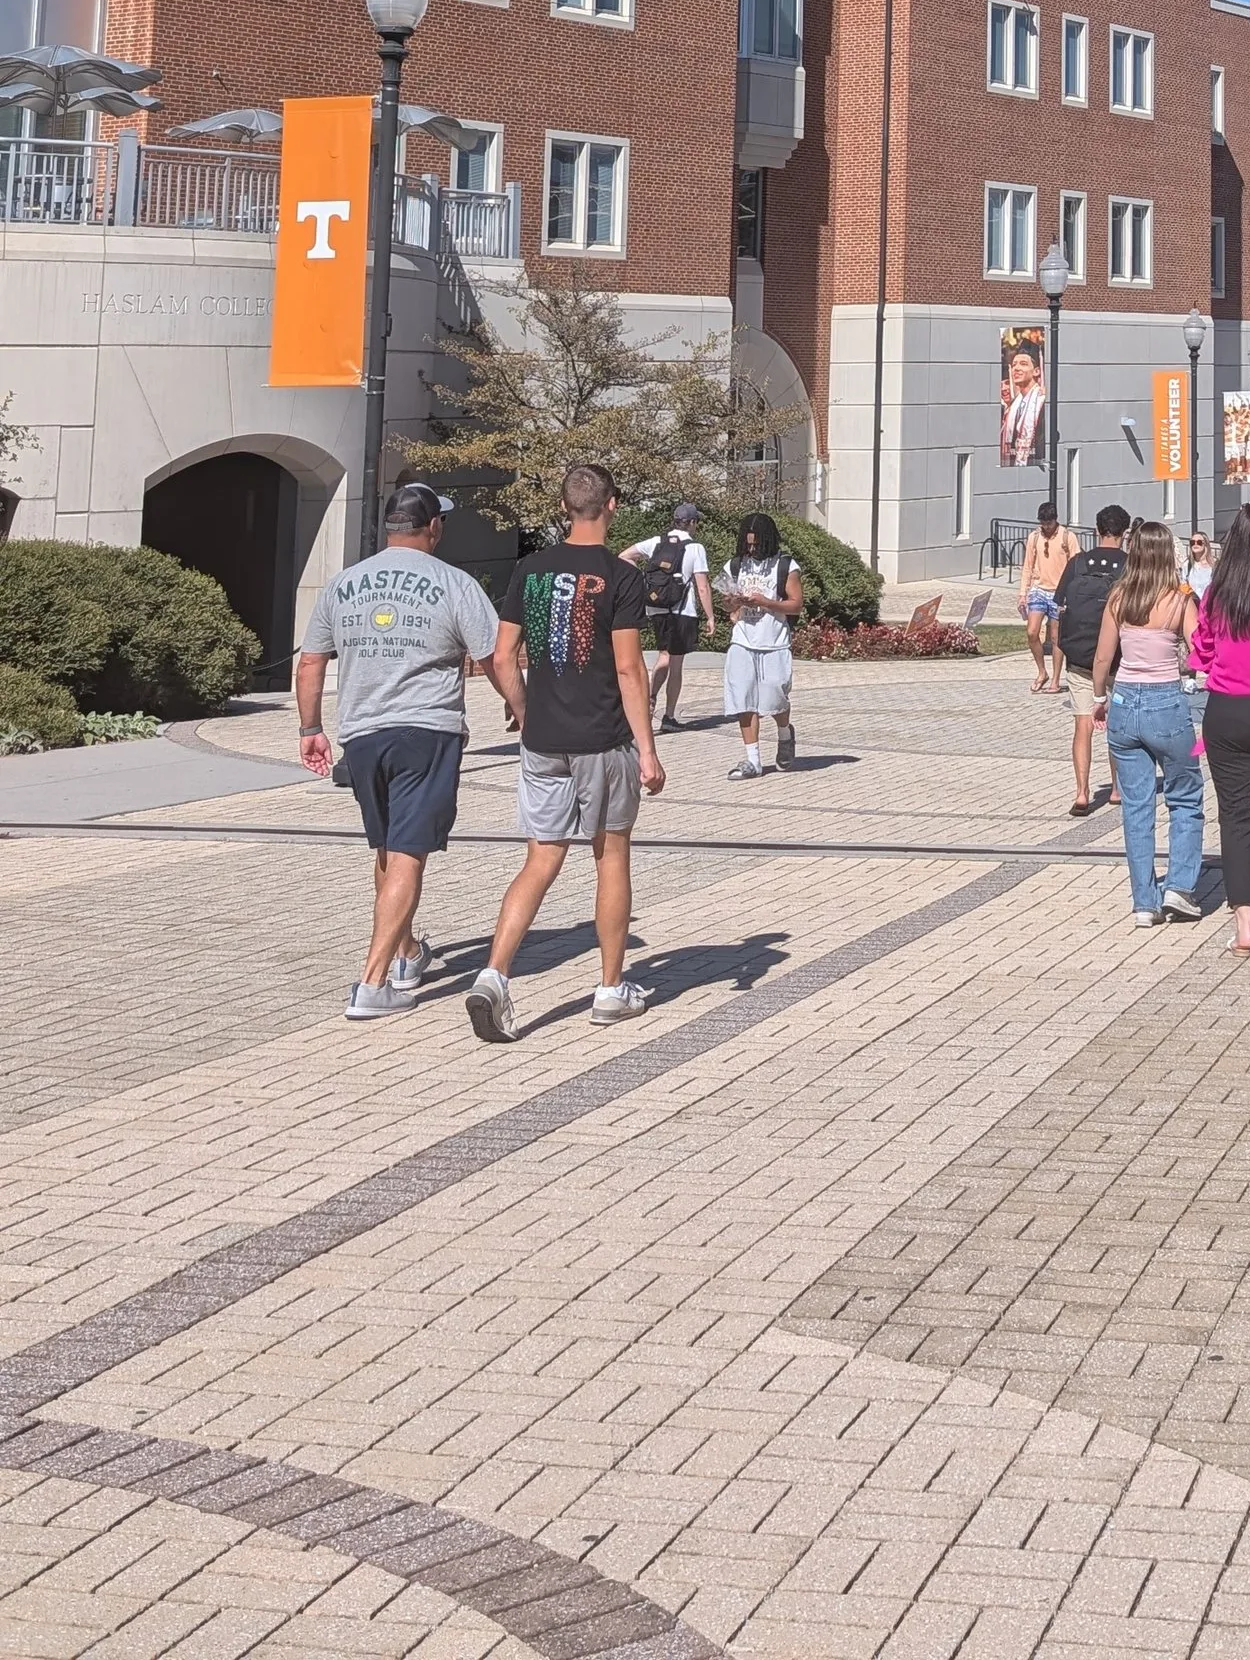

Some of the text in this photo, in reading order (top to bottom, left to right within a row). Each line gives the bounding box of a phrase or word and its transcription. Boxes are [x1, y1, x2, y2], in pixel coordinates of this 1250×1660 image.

[297, 200, 350, 259] T
[82, 294, 188, 315] HASLAM
[1169, 378, 1181, 472] VOLUNTEER
[337, 570, 445, 605] MASTERS
[524, 572, 605, 600] MSP
[351, 591, 422, 609] TOURNAMENT
[342, 614, 431, 629] EST. 1934
[382, 637, 427, 648] NATIONAL
[382, 648, 405, 658] CLUB
